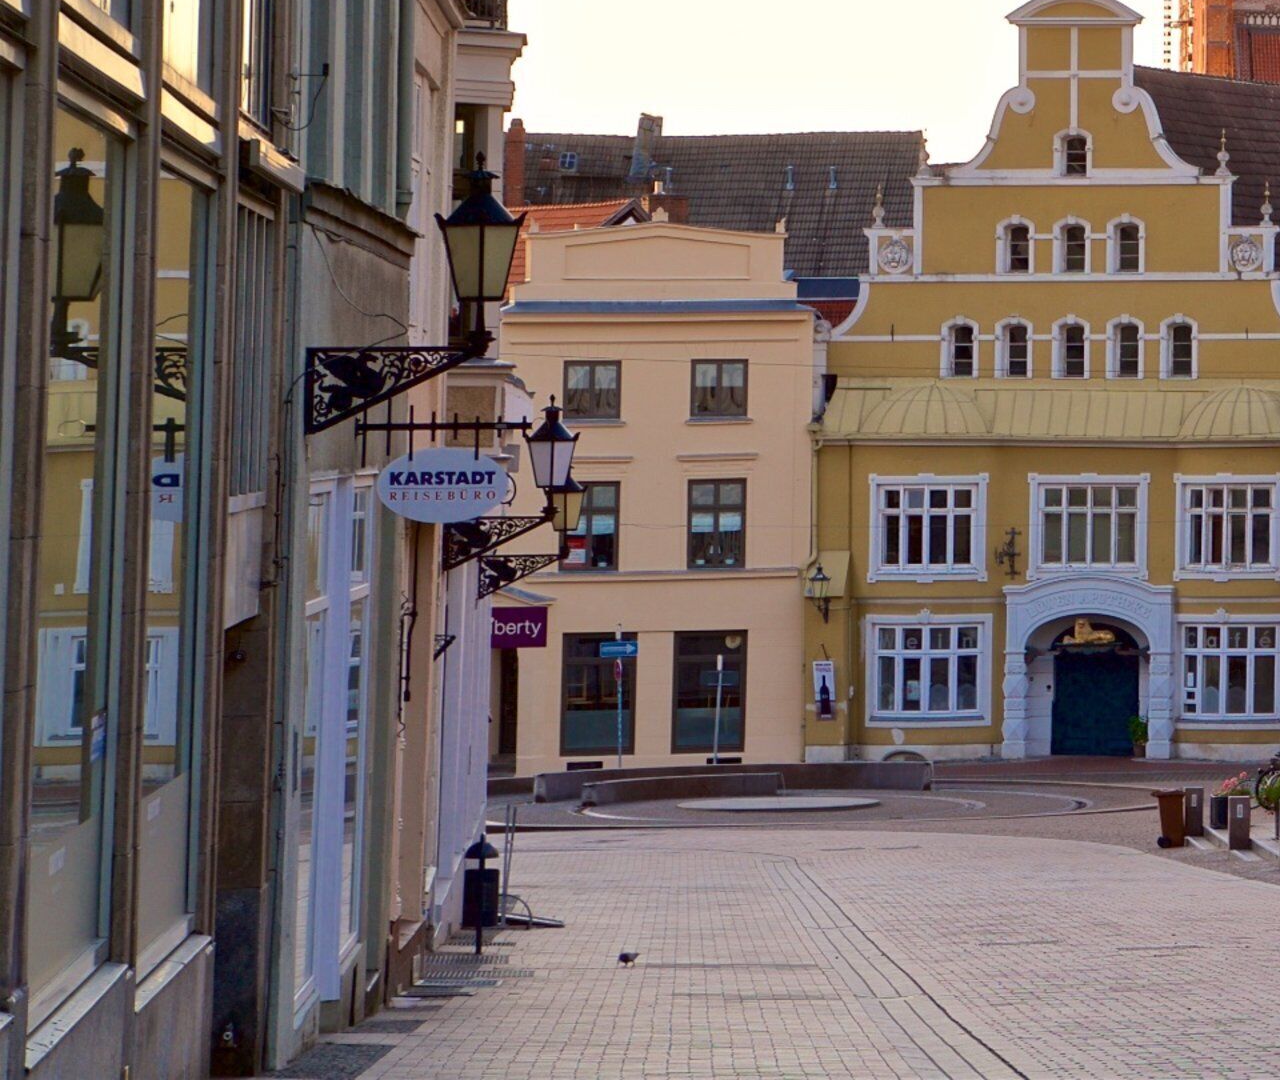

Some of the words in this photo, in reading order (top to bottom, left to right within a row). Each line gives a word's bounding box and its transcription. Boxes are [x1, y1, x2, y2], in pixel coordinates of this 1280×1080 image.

[389, 471, 496, 486] KARSTADT
[389, 488, 496, 501] REISEBÜRO
[492, 619, 542, 637] berty
[881, 629, 974, 649] Wein
[1186, 630, 1271, 648] Café
